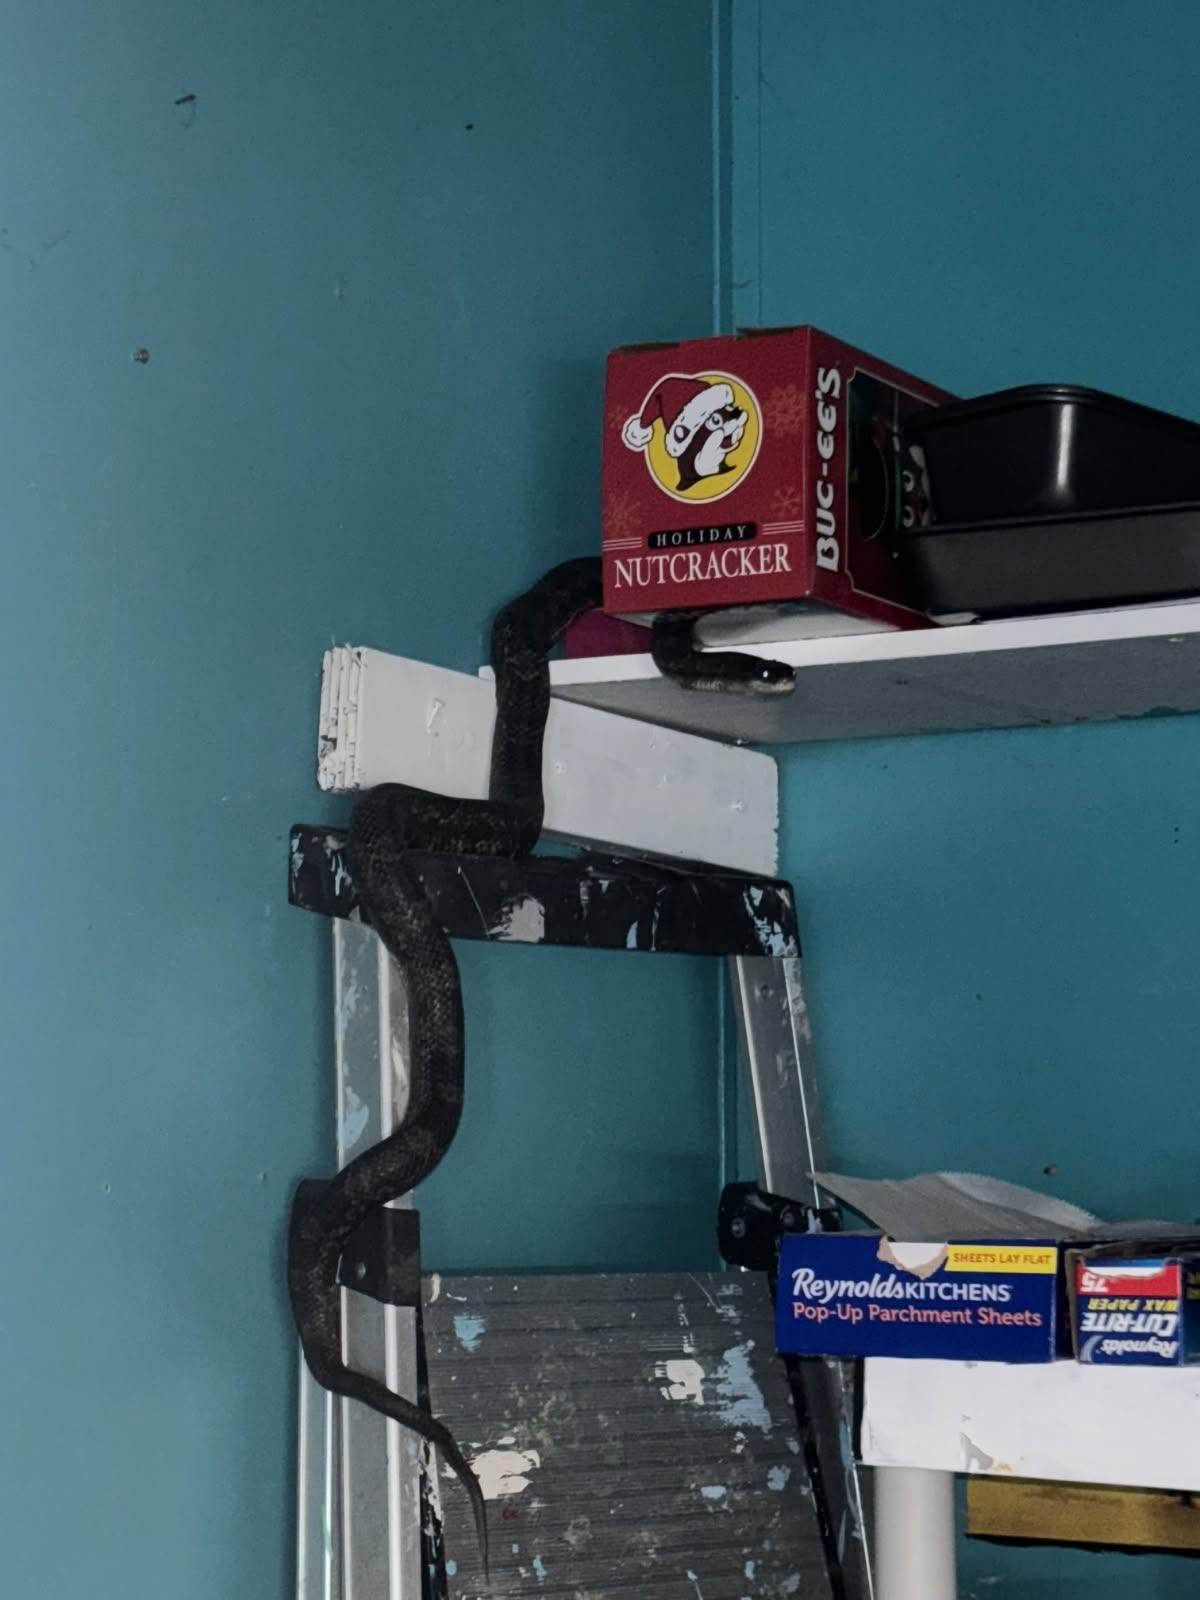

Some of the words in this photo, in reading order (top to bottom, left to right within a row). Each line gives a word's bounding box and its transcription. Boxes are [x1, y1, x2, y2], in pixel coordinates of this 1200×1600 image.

[656, 524, 748, 548] HOLIDAY
[613, 543, 792, 589] NUTCRACKER
[953, 1252, 996, 1264] SHEETS
[999, 1253, 1021, 1264] LAY
[1023, 1254, 1052, 1265] FLAT
[793, 1302, 863, 1325] Pop-Up
[869, 1305, 971, 1325] Parchment
[979, 1307, 1042, 1327] Sheets
[1087, 1298, 1139, 1311] PAPER
[1143, 1299, 1179, 1312] WAX
[1080, 1312, 1178, 1337] CUT-RITE
[1101, 1336, 1179, 1359] Reynolds
